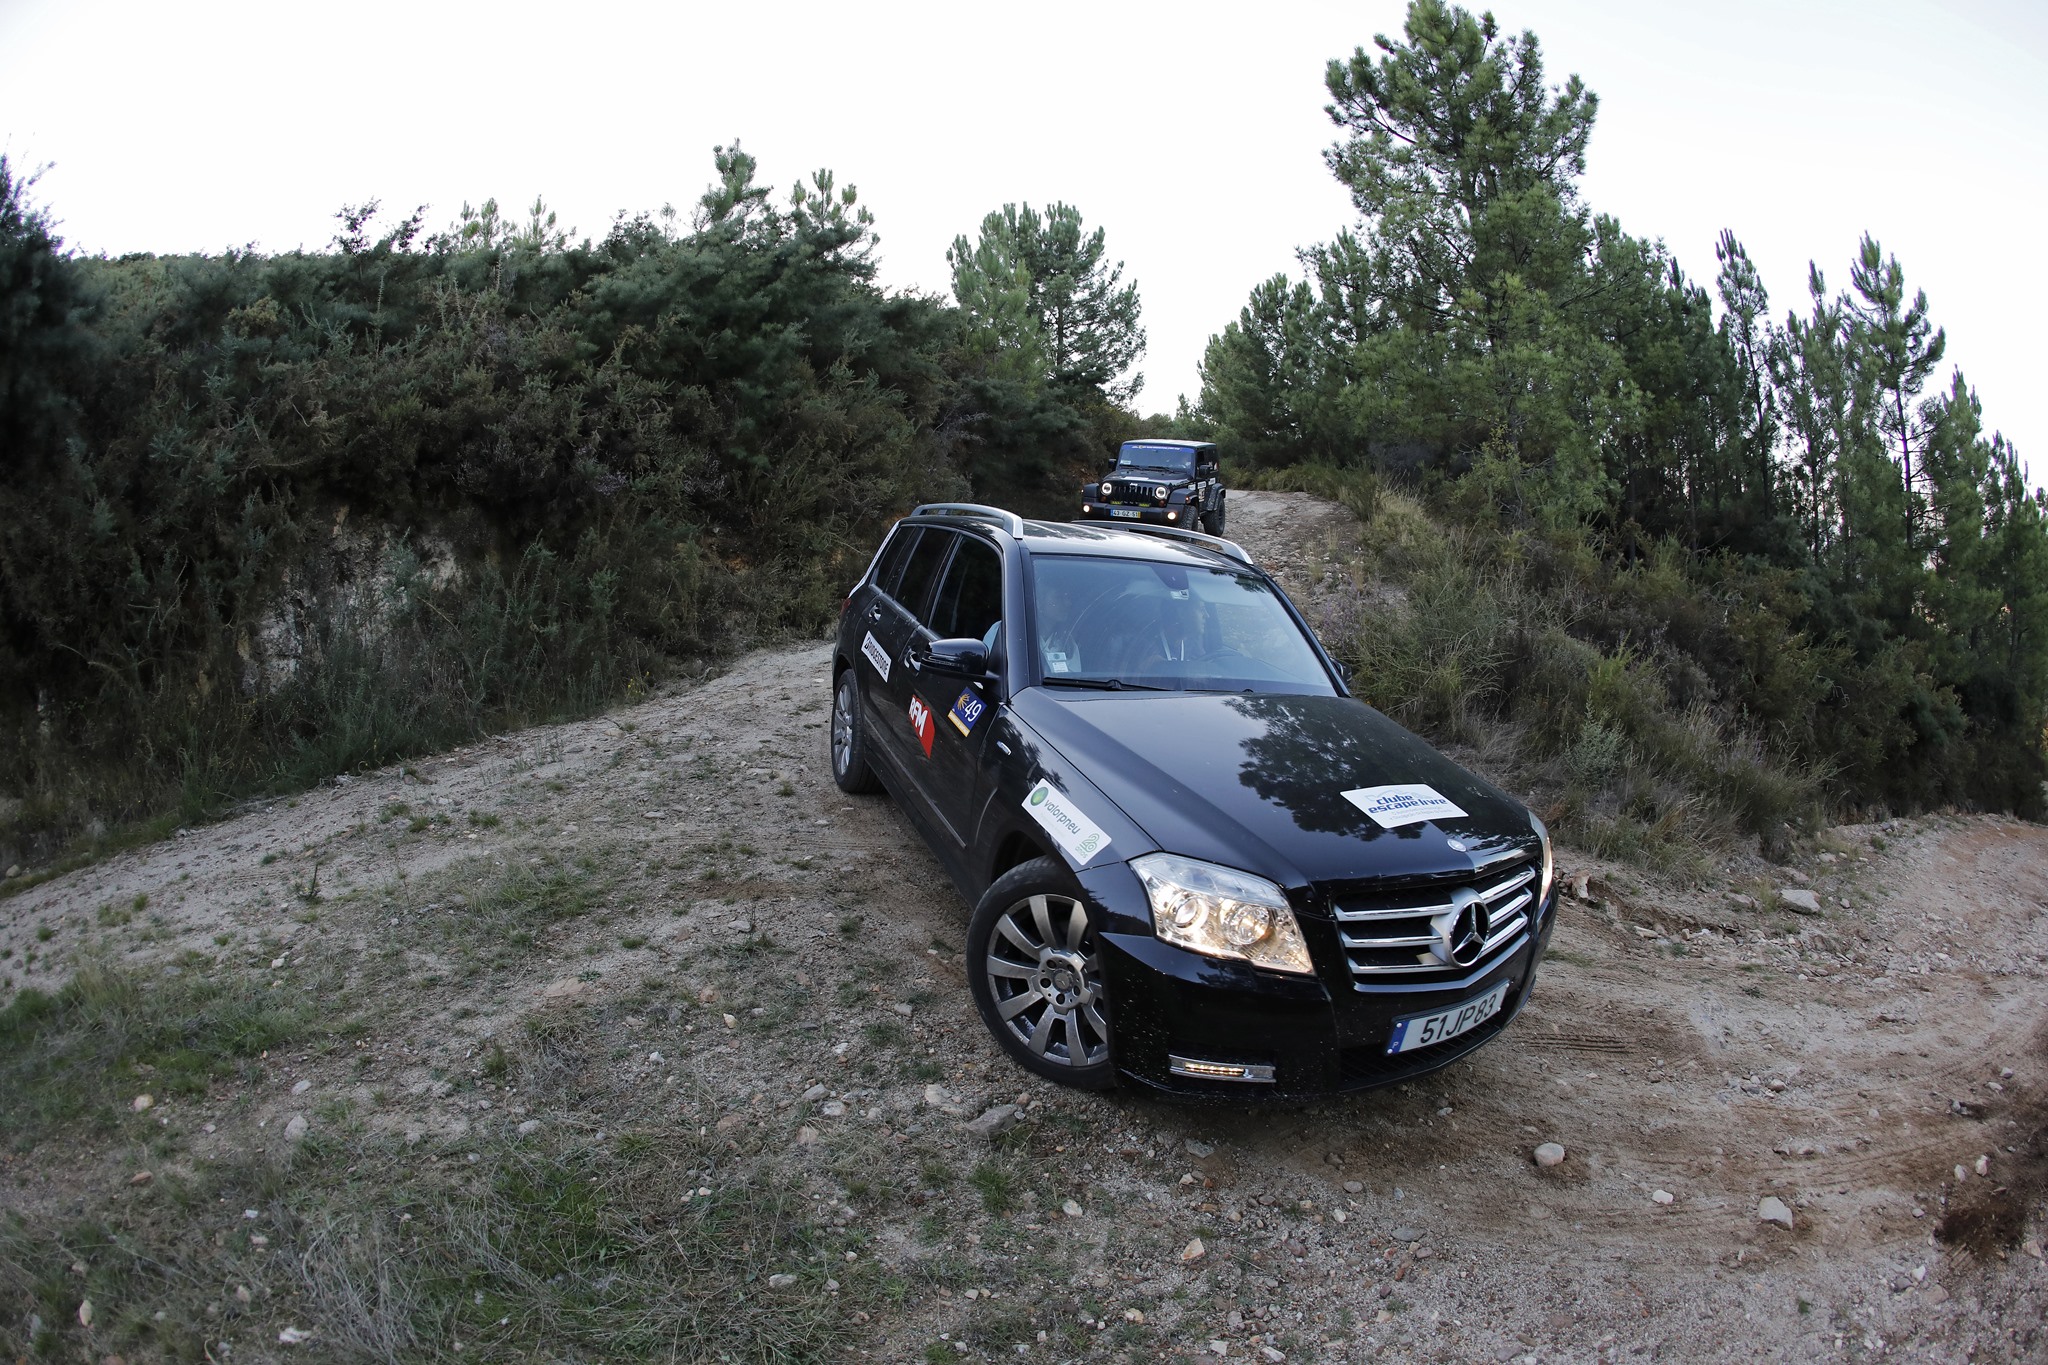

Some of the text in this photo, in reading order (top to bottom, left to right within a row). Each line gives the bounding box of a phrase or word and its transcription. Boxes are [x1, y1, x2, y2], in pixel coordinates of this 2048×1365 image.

[864, 637, 888, 675] BRIDGESTONE
[909, 697, 928, 737] RFM
[965, 700, 981, 722] 49
[1376, 794, 1413, 805] clube
[1044, 800, 1081, 834] valorpneu
[1420, 993, 1497, 1044] 51JP83
[1392, 1041, 1398, 1049] P
